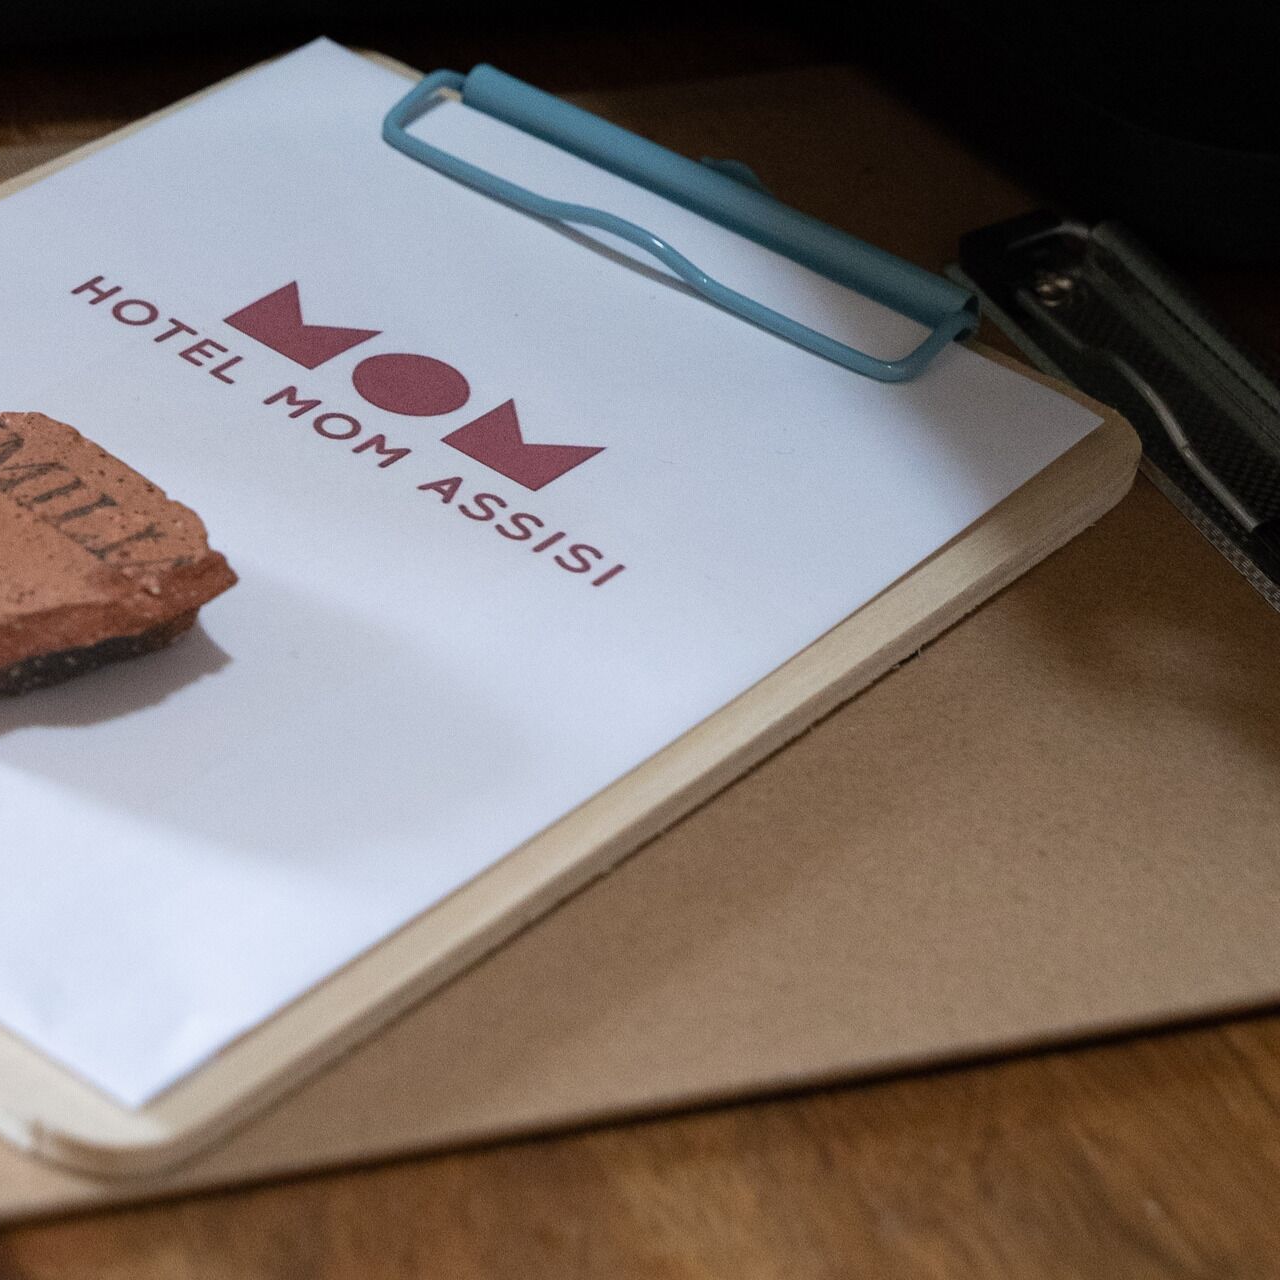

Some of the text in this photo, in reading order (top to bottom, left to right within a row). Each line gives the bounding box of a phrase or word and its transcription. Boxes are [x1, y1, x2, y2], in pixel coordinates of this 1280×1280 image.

[71, 275, 626, 587] HOTEL MOM ASSISI
[223, 280, 608, 492] MOM
